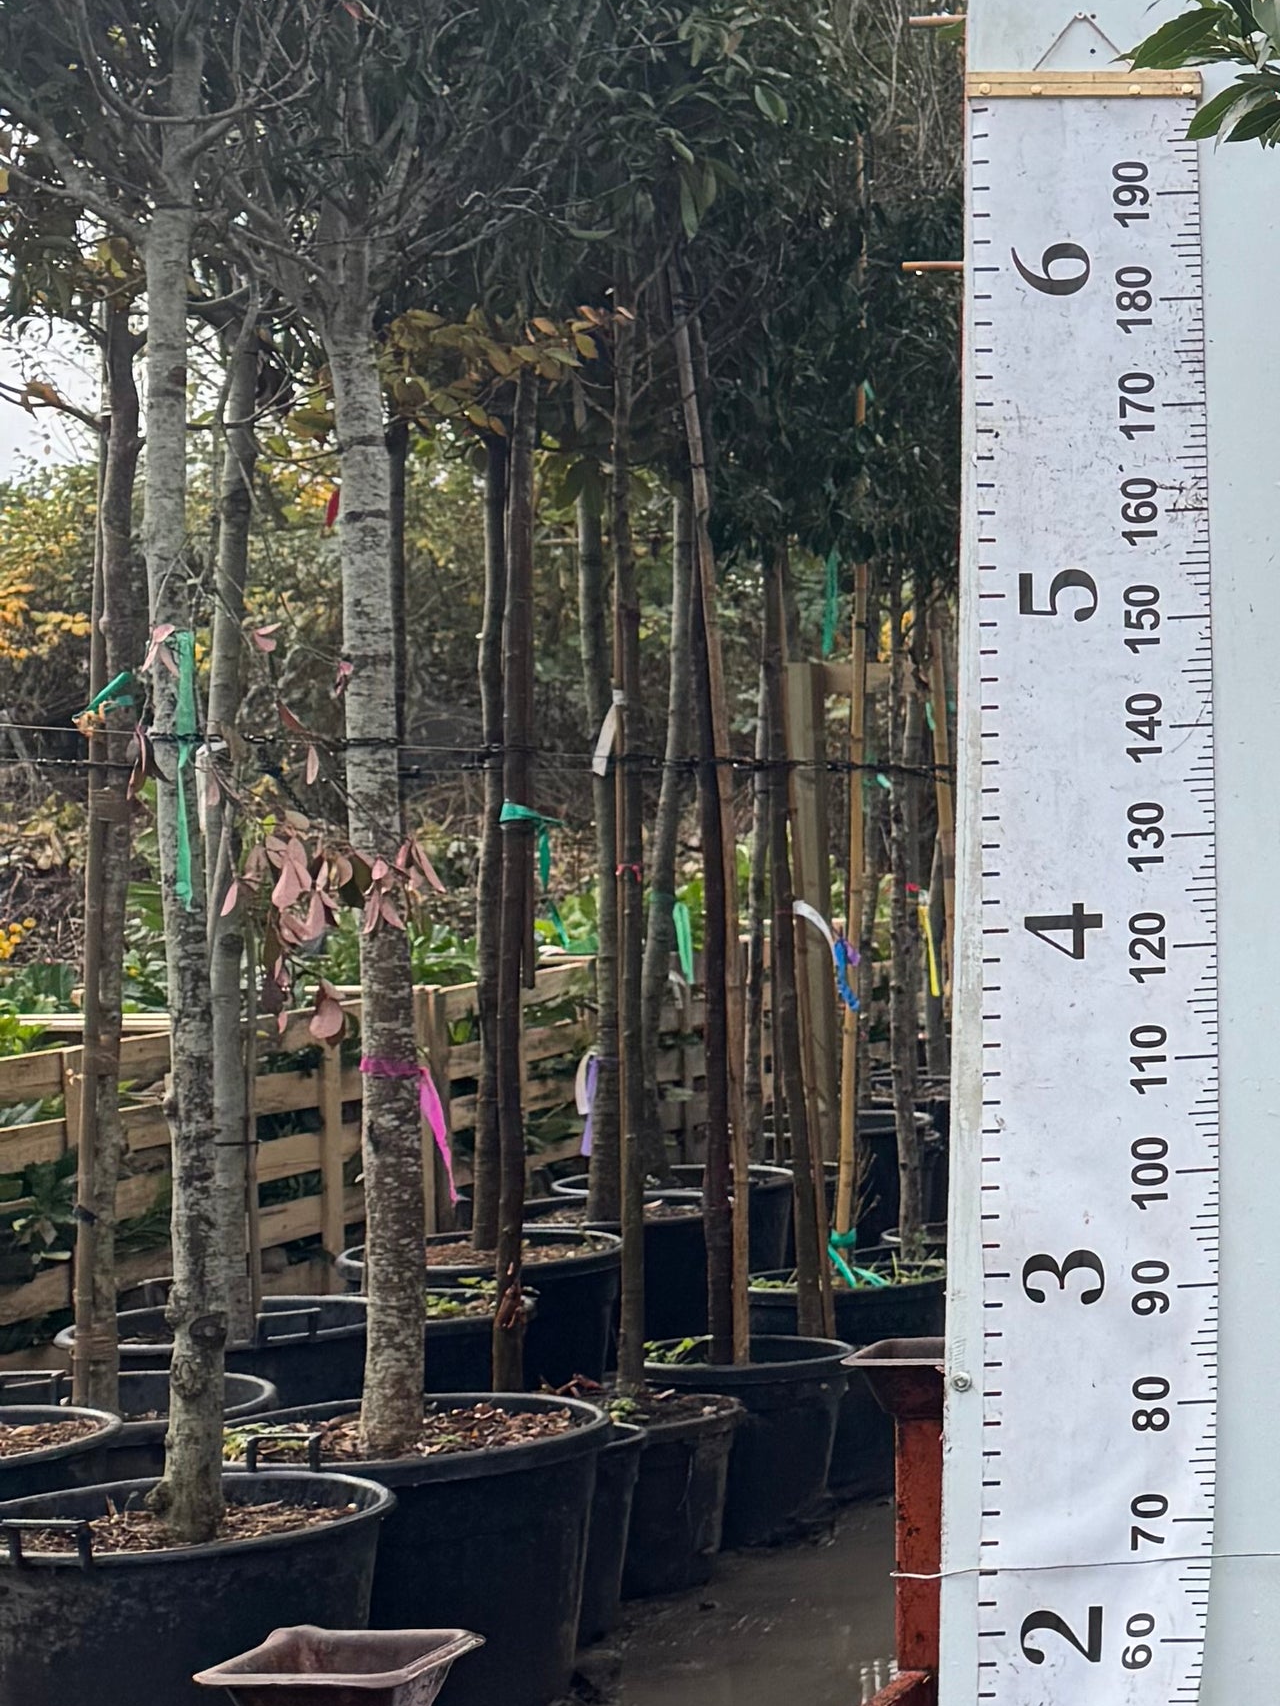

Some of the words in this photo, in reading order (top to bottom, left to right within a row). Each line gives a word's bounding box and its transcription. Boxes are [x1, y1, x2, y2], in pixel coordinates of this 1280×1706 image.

[1111, 160, 1151, 229] 190
[1010, 241, 1091, 297] 6
[1114, 265, 1154, 335] 180
[1117, 371, 1156, 442] 170
[1118, 476, 1160, 548] 160
[1017, 568, 1099, 623] 5
[1122, 583, 1162, 655] 150
[1124, 692, 1164, 764] 140
[1126, 801, 1166, 874] 130
[1023, 901, 1104, 961] 4
[1127, 911, 1167, 985] 120
[1128, 1024, 1169, 1096] 110
[1129, 1136, 1170, 1212] 100
[1021, 1248, 1106, 1306] 3
[1130, 1259, 1171, 1317] 90
[1130, 1375, 1171, 1433] 80
[1129, 1492, 1170, 1552] 70
[1019, 1604, 1104, 1666] 2
[1120, 1612, 1156, 1671] 60
